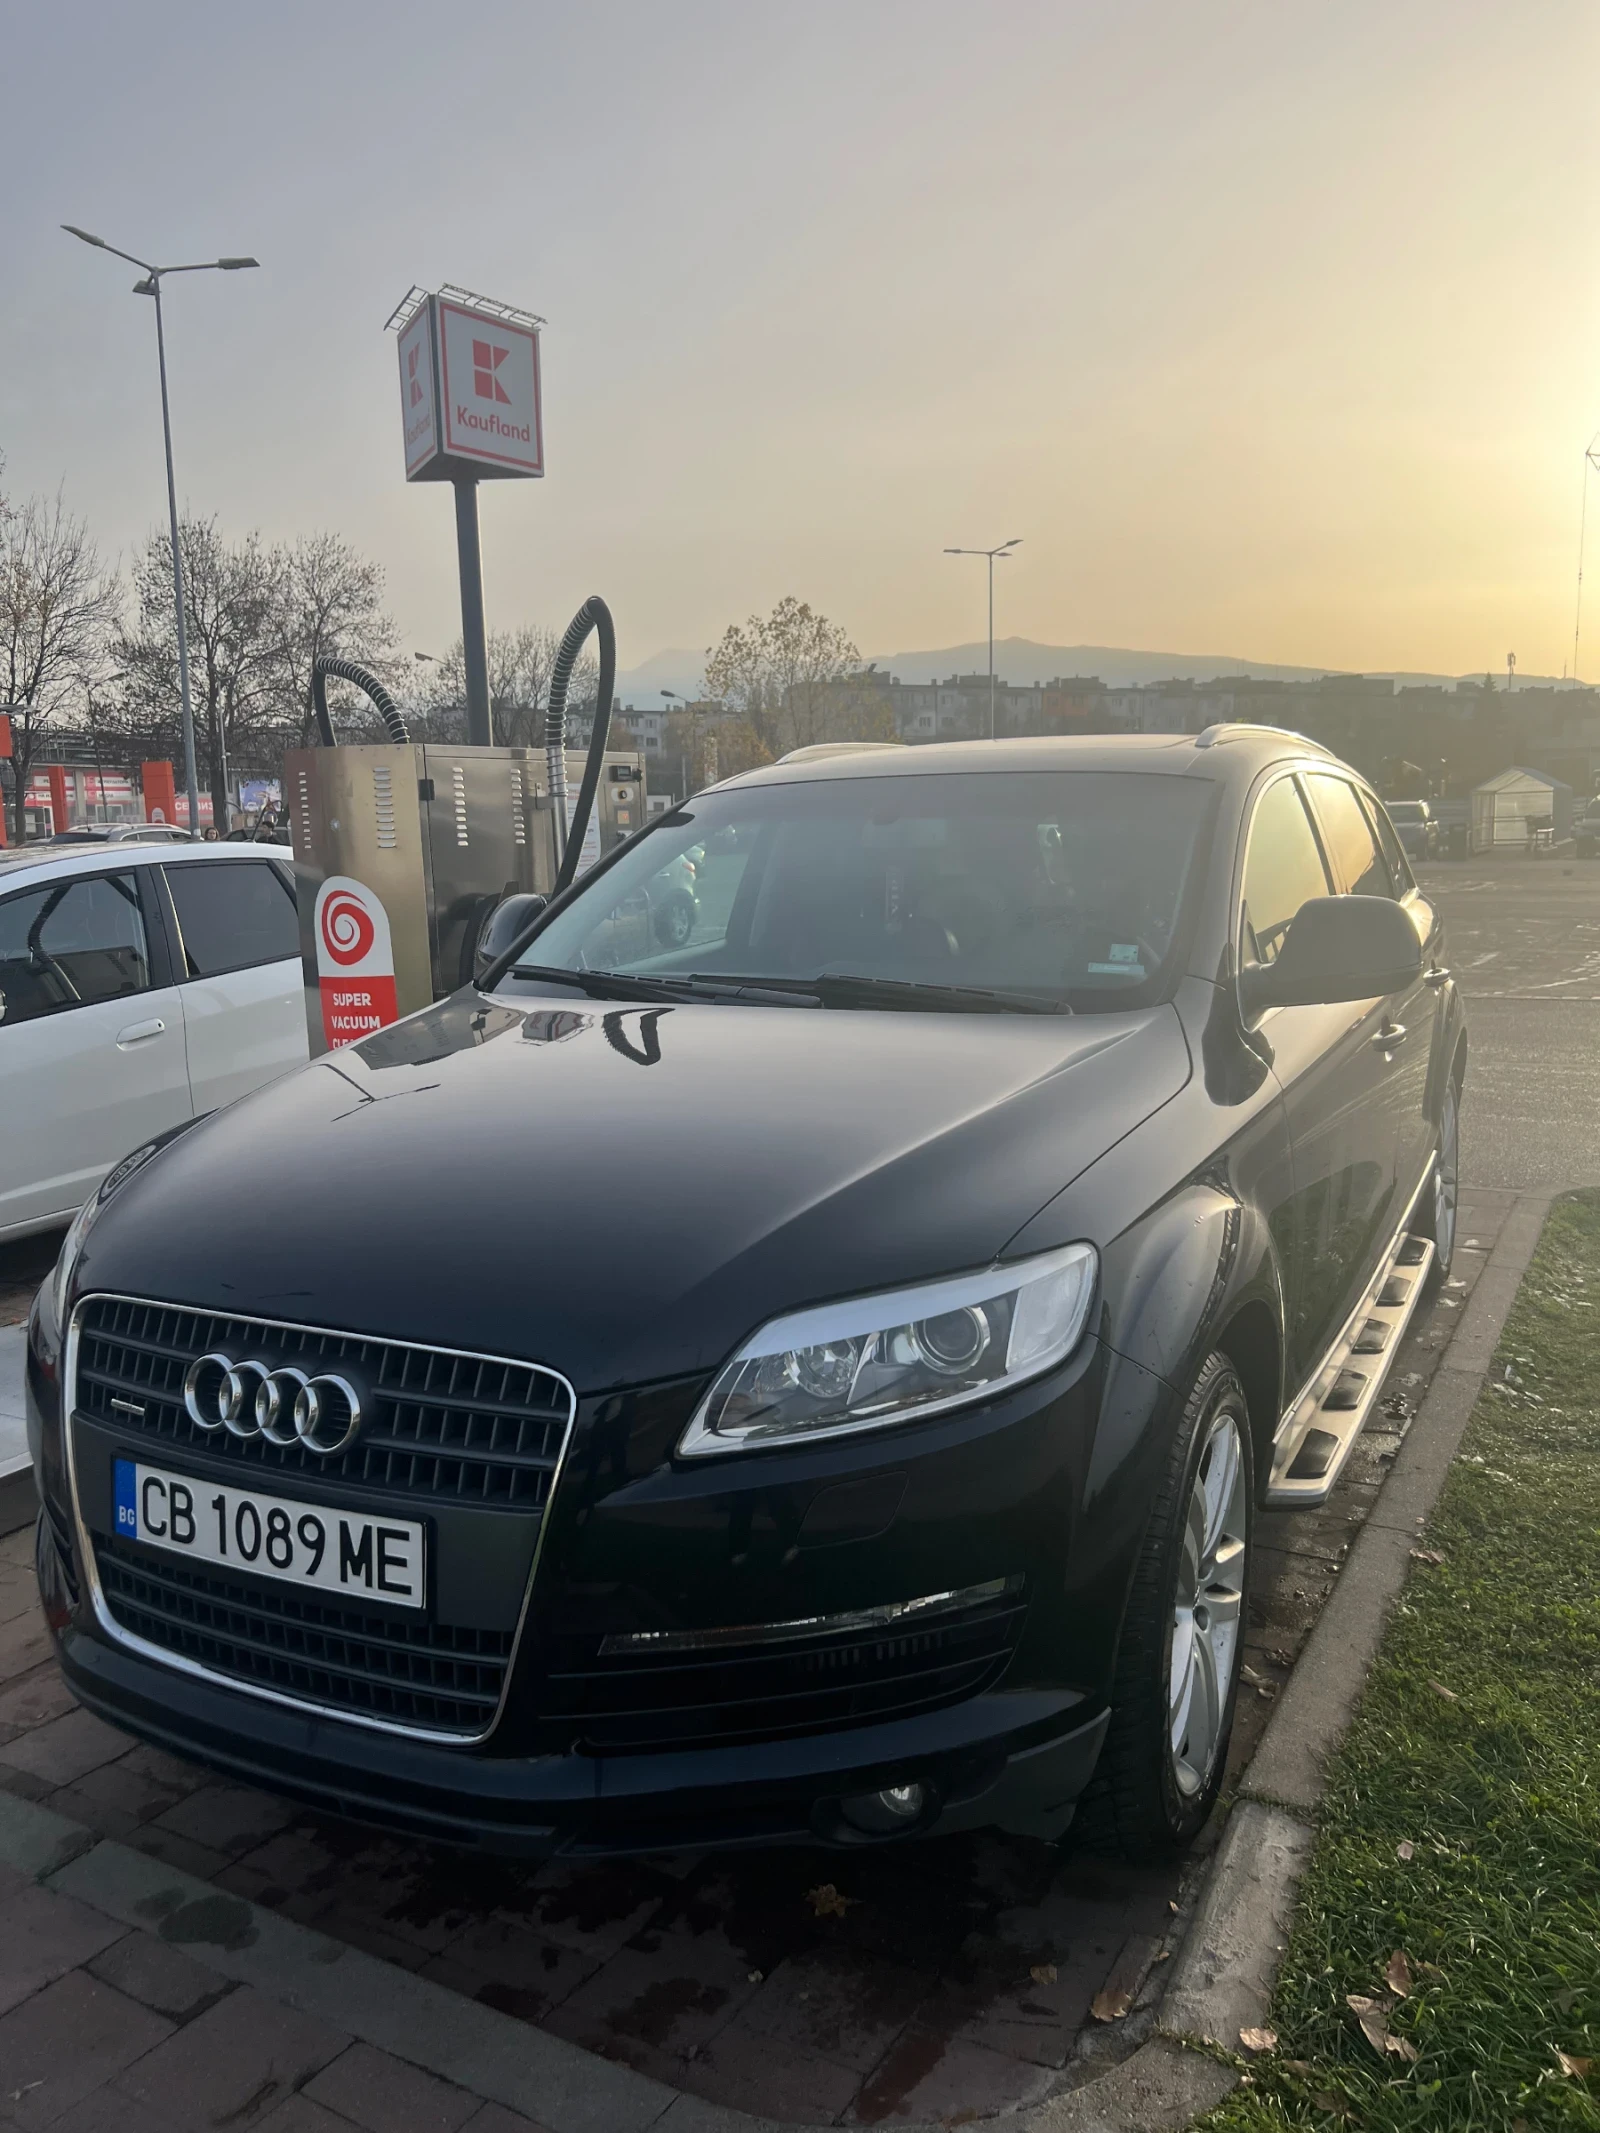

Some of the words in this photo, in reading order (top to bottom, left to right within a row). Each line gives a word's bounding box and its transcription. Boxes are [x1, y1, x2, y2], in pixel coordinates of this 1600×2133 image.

[457, 405, 531, 442] Kaufland
[332, 993, 372, 1006] SUPER
[331, 1015, 380, 1029] VACUUM
[118, 1505, 135, 1524] BG
[142, 1476, 196, 1544] CB
[212, 1494, 326, 1576] 1089
[339, 1520, 412, 1596] ME
